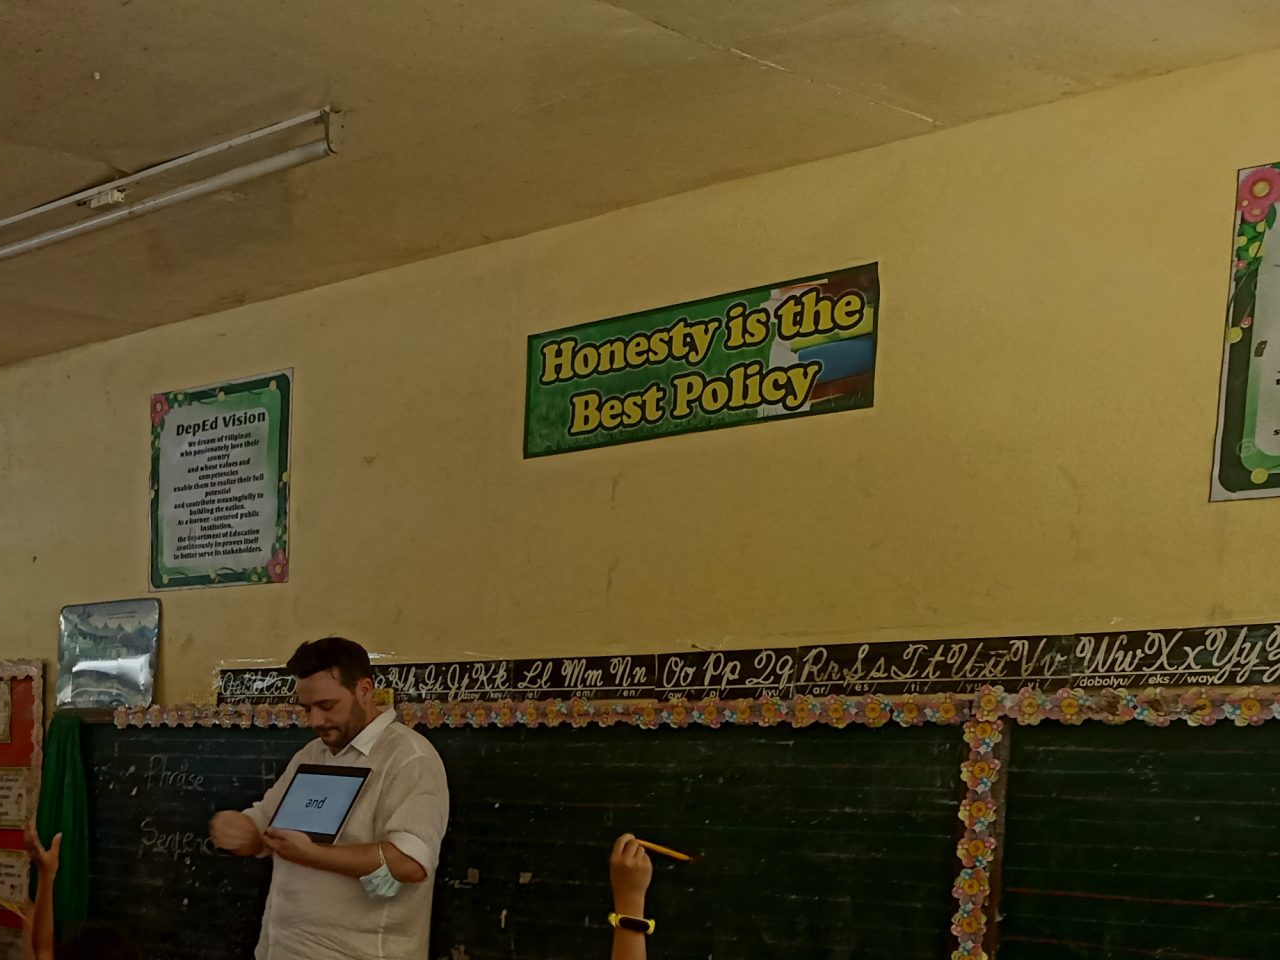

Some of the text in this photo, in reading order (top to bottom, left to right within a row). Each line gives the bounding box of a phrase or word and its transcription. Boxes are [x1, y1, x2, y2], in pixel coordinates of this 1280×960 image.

[541, 290, 864, 384] Honesty is the
[570, 361, 822, 434] Best Policy
[176, 412, 265, 436] DepEd Vision
[229, 529, 259, 537] Education
[240, 510, 259, 520] public
[517, 661, 553, 688] Ll
[561, 659, 603, 688] Mm
[610, 657, 647, 686] Nn
[663, 656, 696, 688] Oo
[702, 653, 740, 690] Pp
[745, 649, 794, 690] Qq
[800, 647, 840, 683] Rr
[843, 644, 888, 687] Ss
[890, 644, 945, 680] Tt
[1076, 634, 1144, 674] Ww
[1143, 631, 1205, 671] Xx
[1204, 627, 1263, 684] Yy
[144, 754, 204, 791] Phrase
[305, 796, 328, 809] and
[140, 817, 213, 856] Sentenc
